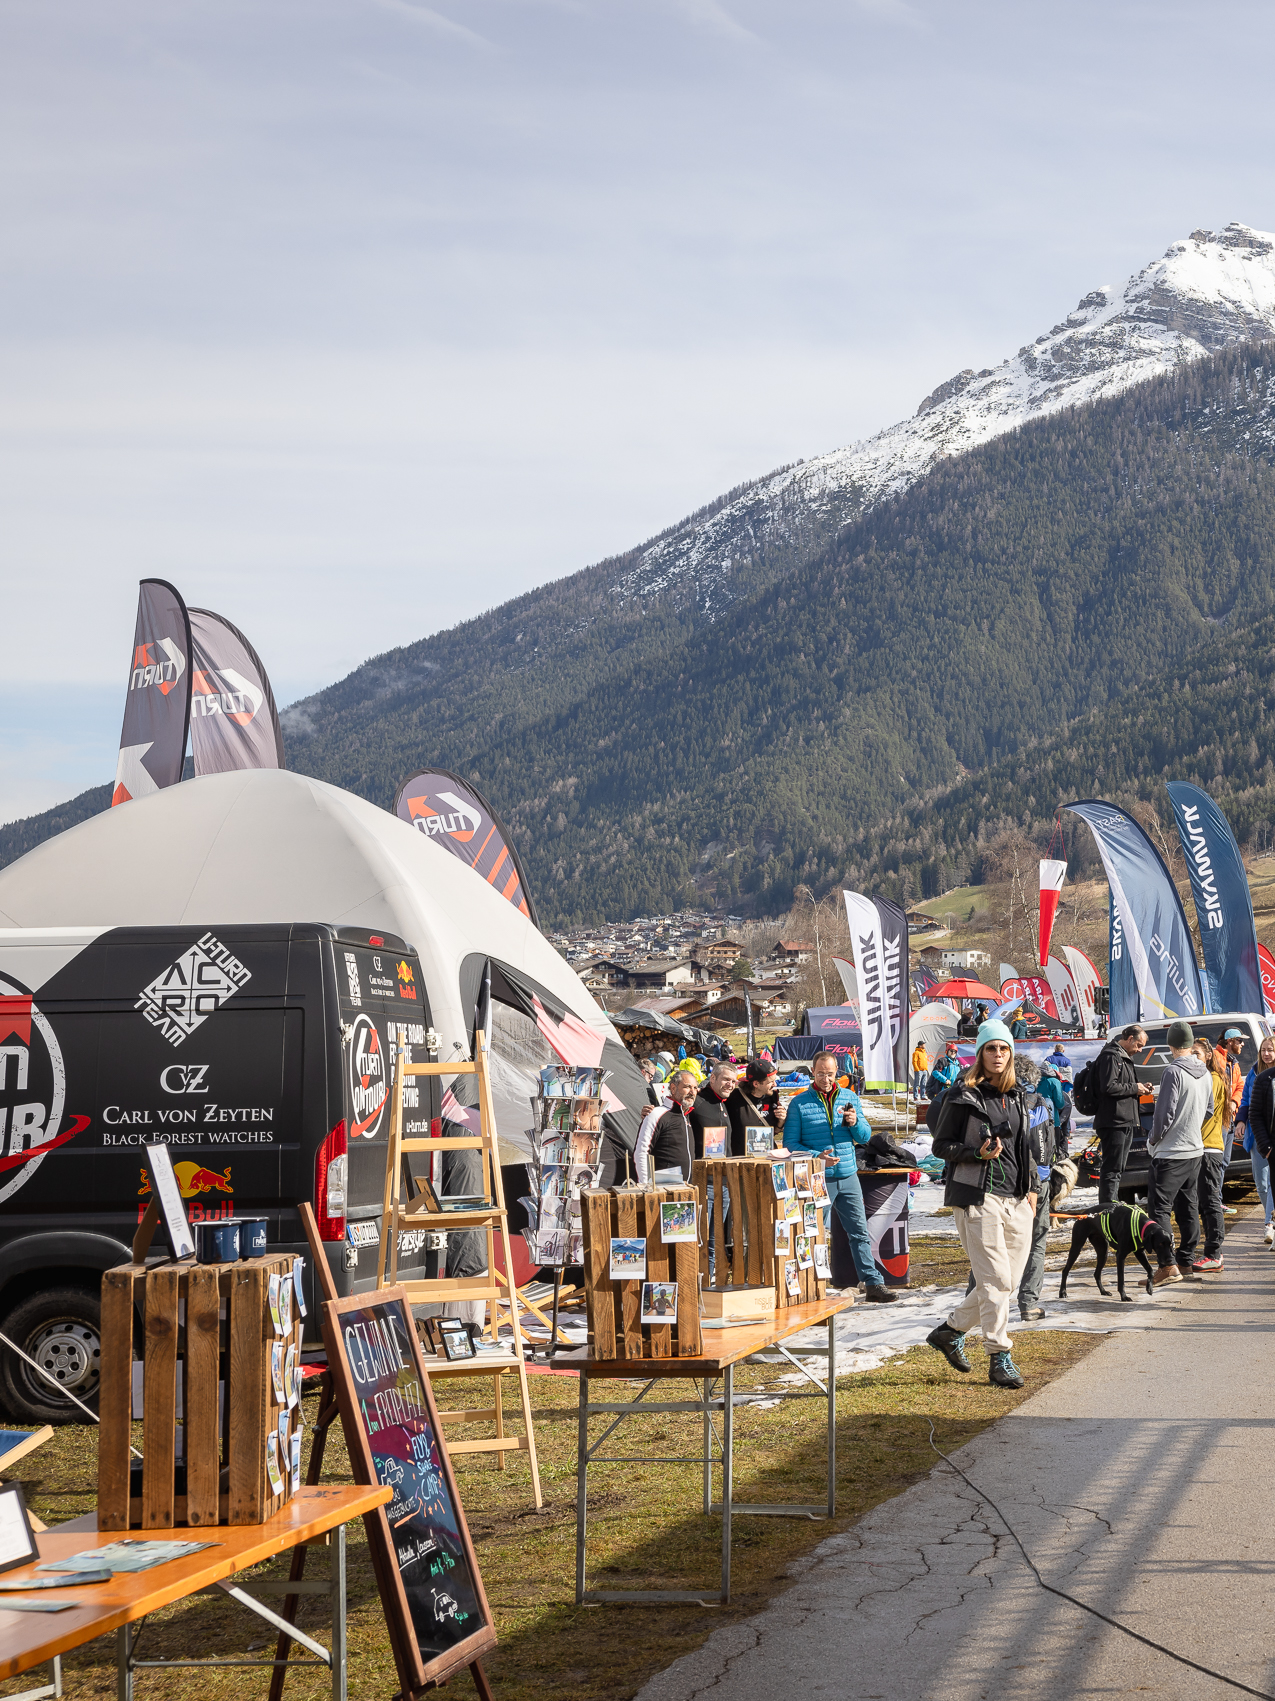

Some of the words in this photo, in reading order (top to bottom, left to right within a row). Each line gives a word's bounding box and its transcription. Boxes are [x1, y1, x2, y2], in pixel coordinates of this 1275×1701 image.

[133, 992, 186, 1047] TEAM
[188, 1200, 233, 1223] Bull
[755, 1297, 773, 1305] TISSUE
[762, 1303, 773, 1311] BOX
[345, 1316, 410, 1384] GEWINNE
[374, 1381, 424, 1430] FREIPLATZ
[421, 1474, 439, 1500] CAMP
